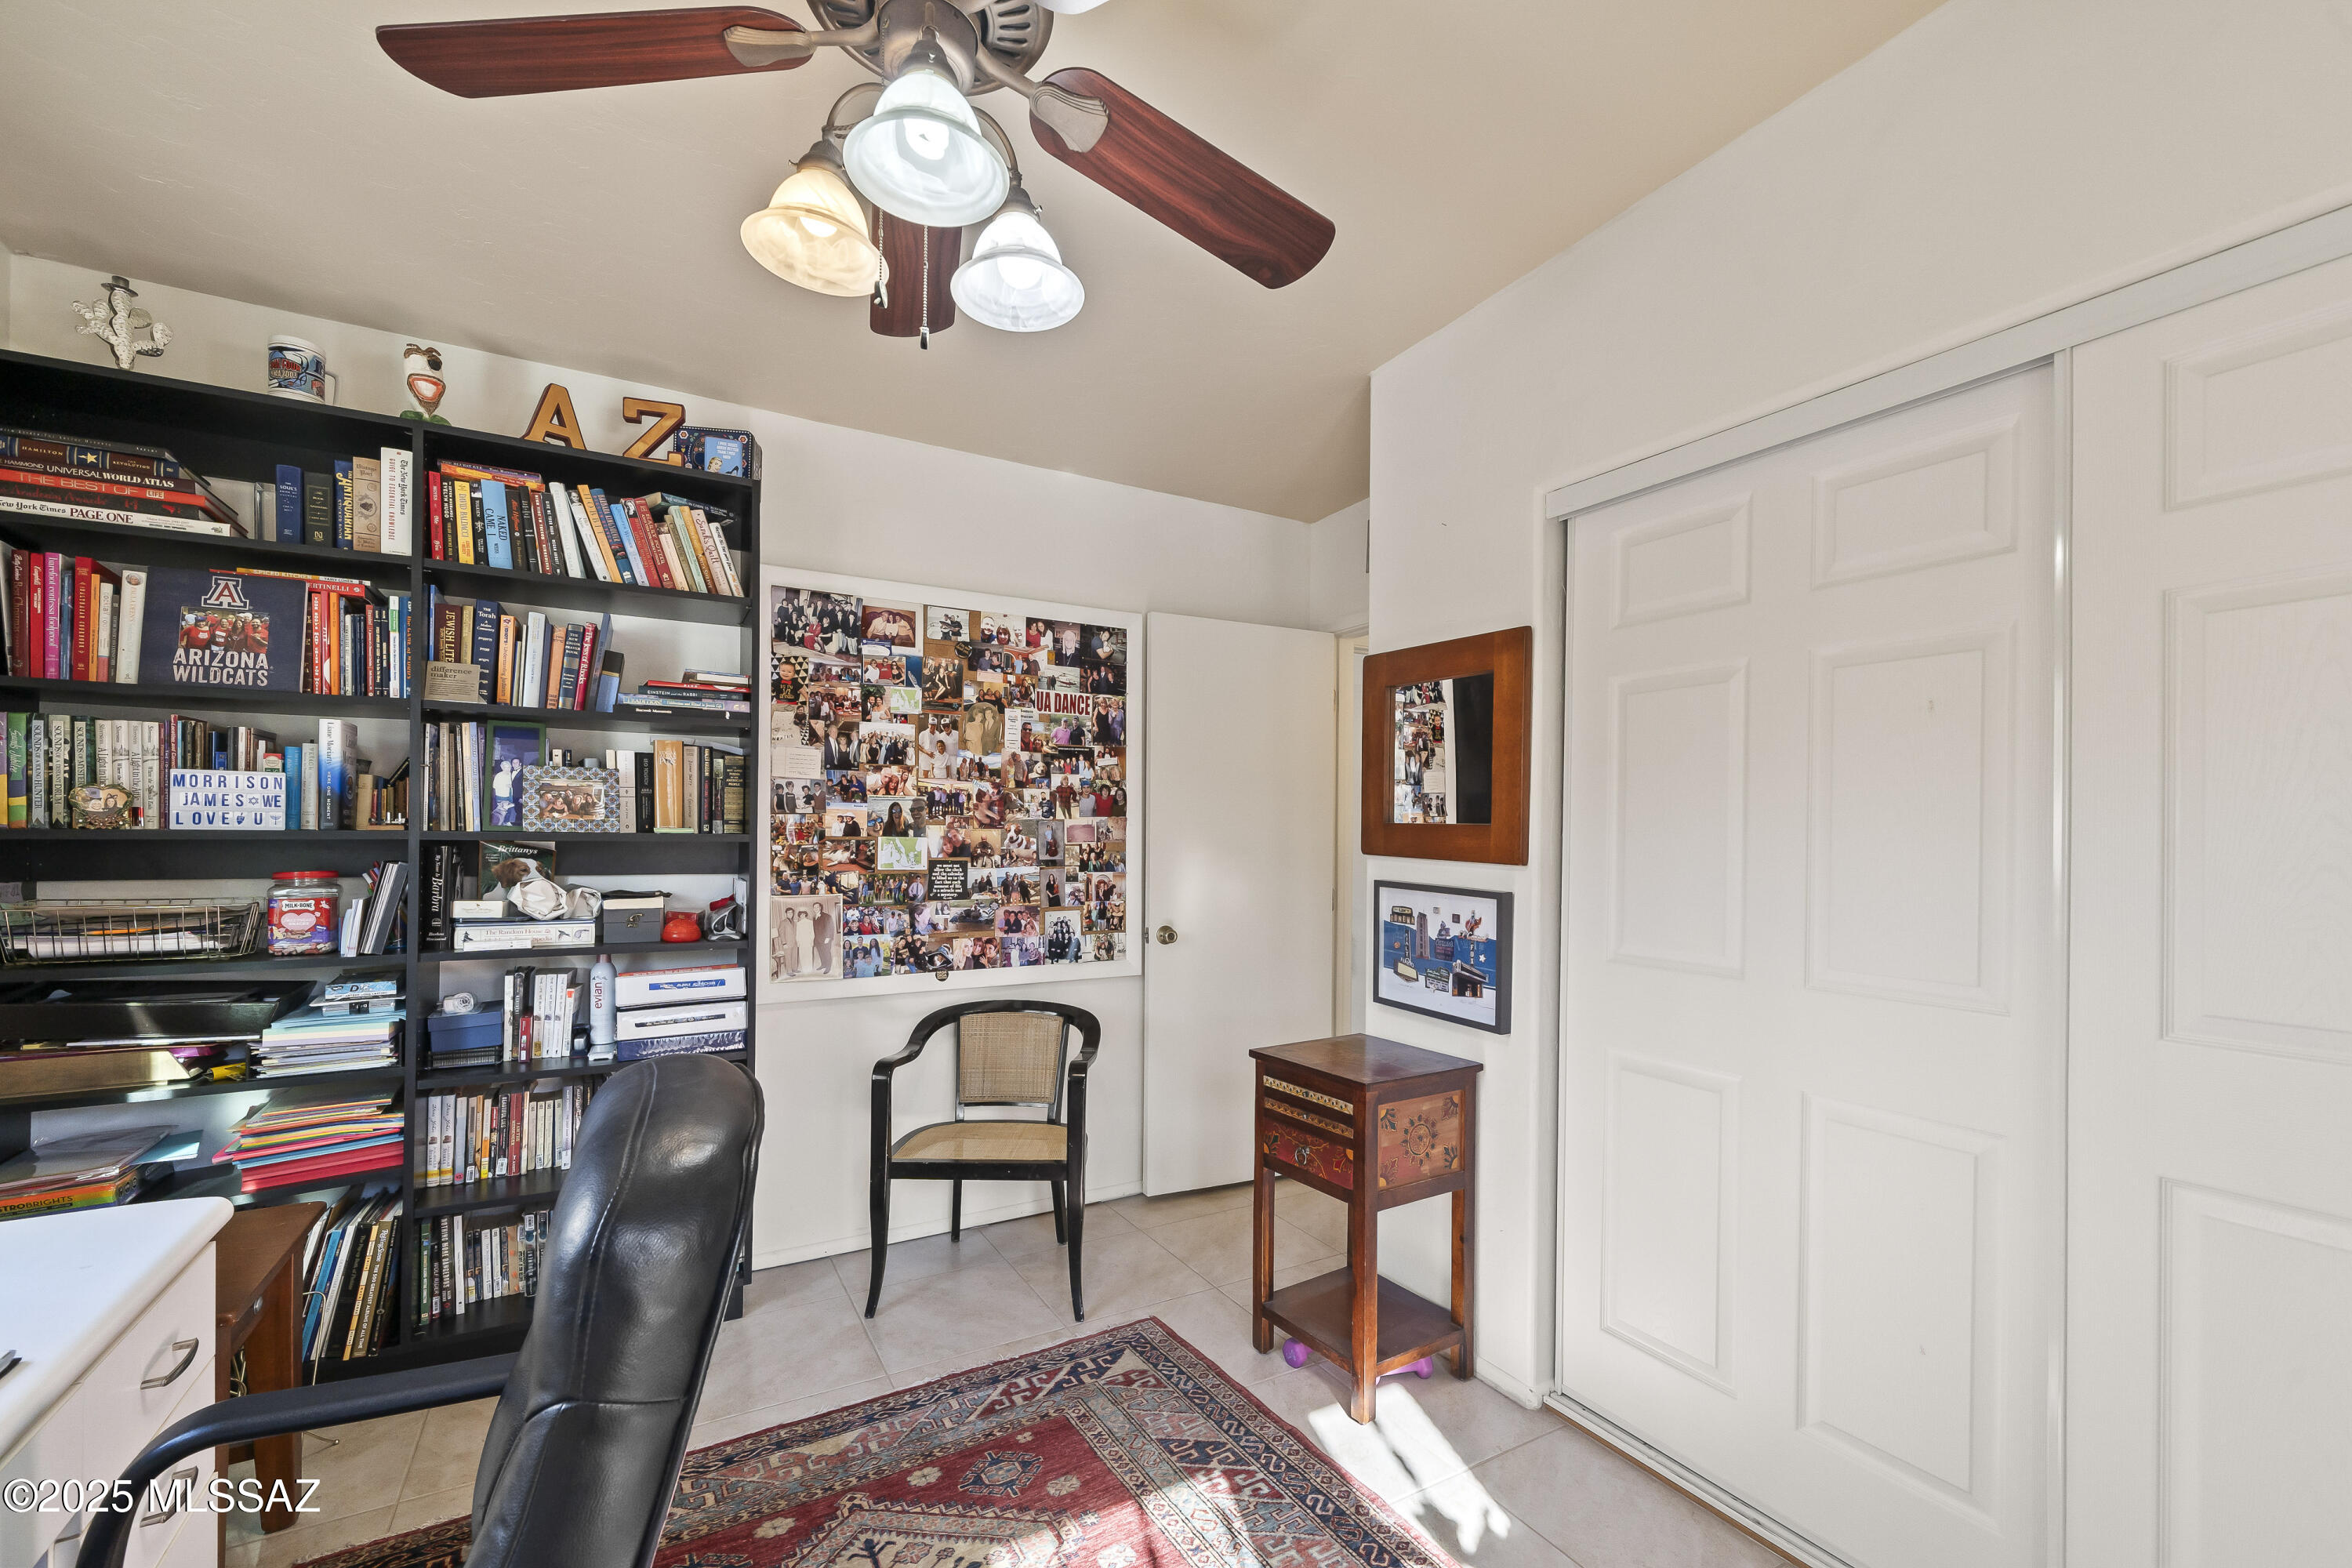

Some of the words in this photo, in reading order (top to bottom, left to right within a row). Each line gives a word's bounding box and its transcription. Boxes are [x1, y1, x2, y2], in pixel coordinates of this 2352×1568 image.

[522, 383, 586, 450] A
[622, 397, 686, 467] Z
[22, 445, 63, 456] HAMILTON
[4, 459, 44, 469] HAMMOND
[47, 466, 103, 479] UNIVERSAL
[103, 472, 141, 485] WORLD
[144, 477, 174, 488] ATLAS
[20, 472, 55, 485] THE
[60, 479, 107, 492] BEST
[114, 485, 139, 495] OF
[398, 483, 408, 496] York
[336, 472, 353, 541] ANTIQUARIAN
[459, 493, 467, 510] DAVID
[16, 502, 38, 511] York
[39, 504, 66, 514] Times
[70, 507, 104, 521] PAGE
[107, 512, 133, 525] ONE
[459, 511, 469, 538] BALDACCI
[485, 508, 495, 529] CAME
[583, 494, 604, 535] HOBBIT
[497, 514, 508, 541] NAKED
[604, 514, 621, 543] KINGSOLVER
[646, 514, 657, 539] HARRY
[654, 539, 665, 564] POTTER
[696, 518, 712, 544] Sarah's
[706, 544, 720, 564] Quilt
[13, 554, 23, 565] Betty
[49, 557, 58, 585] barefoot
[308, 582, 350, 592] ERTINELLI
[49, 586, 58, 615] contessa
[13, 596, 24, 632] Christmas
[45, 616, 58, 647] foolproof
[445, 610, 455, 641] JEWISH
[172, 648, 268, 670] ARIZONA
[431, 666, 472, 674] difference
[173, 665, 268, 687] WILDCATS
[579, 663, 588, 684] Rhodes
[1036, 691, 1051, 713] UA
[1054, 693, 1091, 715] DANCE
[9, 728, 22, 749] Sounds
[54, 725, 63, 752] SOUNDS
[10, 750, 24, 773] Jubilee
[97, 754, 108, 768] Light
[130, 757, 141, 771] Light
[100, 776, 109, 786] the
[132, 778, 141, 787] the
[172, 773, 282, 790] MORRISON
[54, 784, 63, 804] DRUM
[132, 787, 141, 801] Attic
[262, 795, 281, 808] WE
[176, 811, 230, 825] LOVE
[254, 812, 263, 825] U
[499, 845, 538, 855] Brittanys
[431, 877, 442, 912] Barbra
[442, 1258, 452, 1288] DANGEROUS
[367, 1283, 376, 1305] GREATEST
[362, 1305, 372, 1323] ALBUMS
